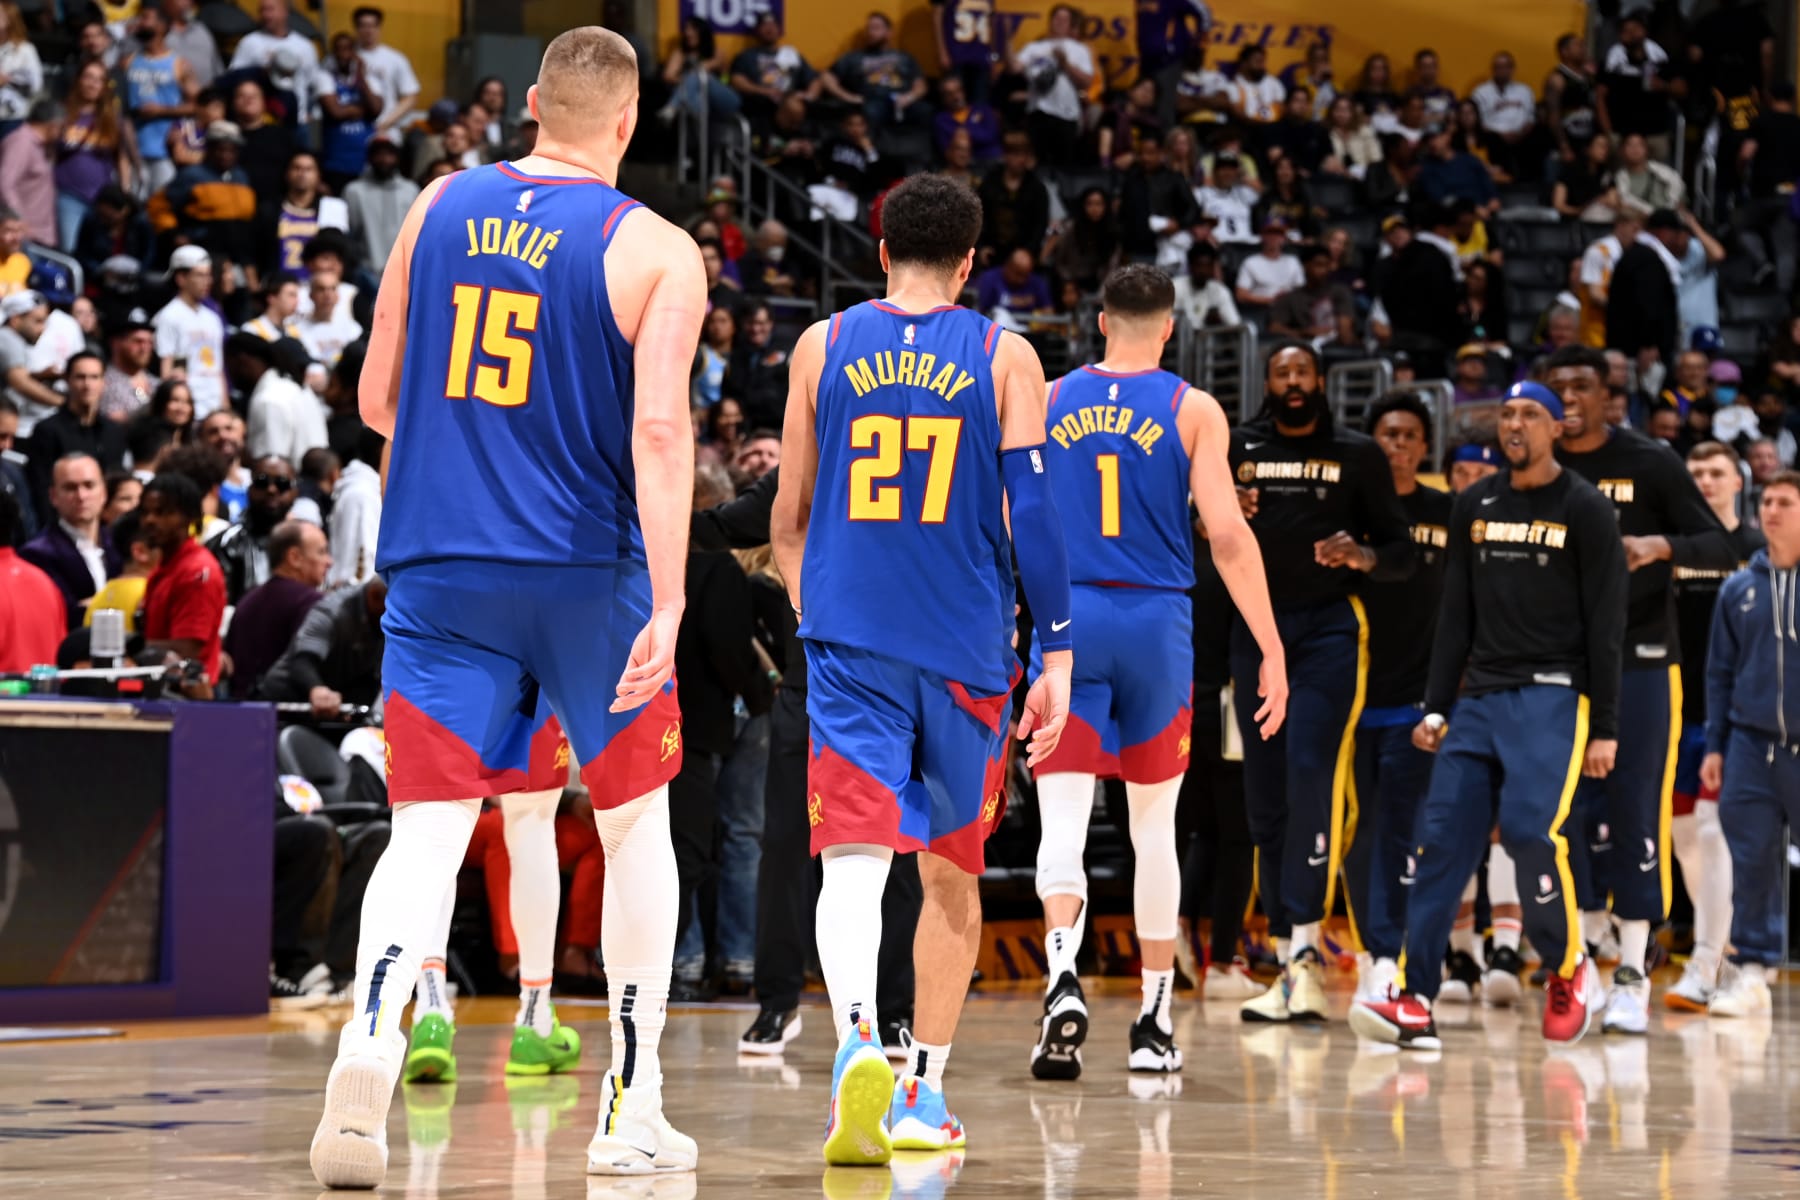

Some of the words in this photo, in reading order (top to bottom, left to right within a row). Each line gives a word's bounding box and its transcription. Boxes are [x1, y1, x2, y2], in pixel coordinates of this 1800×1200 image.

[466, 217, 564, 270] JOKIĆ
[444, 282, 542, 408] 15
[843, 350, 976, 402] MURRAY
[1050, 405, 1134, 449] PORTER
[1130, 417, 1164, 456] JR.
[848, 412, 964, 524] 27
[1256, 461, 1304, 479] BRING
[1303, 461, 1321, 479] IT
[1321, 463, 1341, 483] IN
[1096, 453, 1121, 537] 1
[1485, 521, 1530, 543] BRING
[1527, 523, 1547, 544] IT
[1545, 526, 1567, 549] IN
